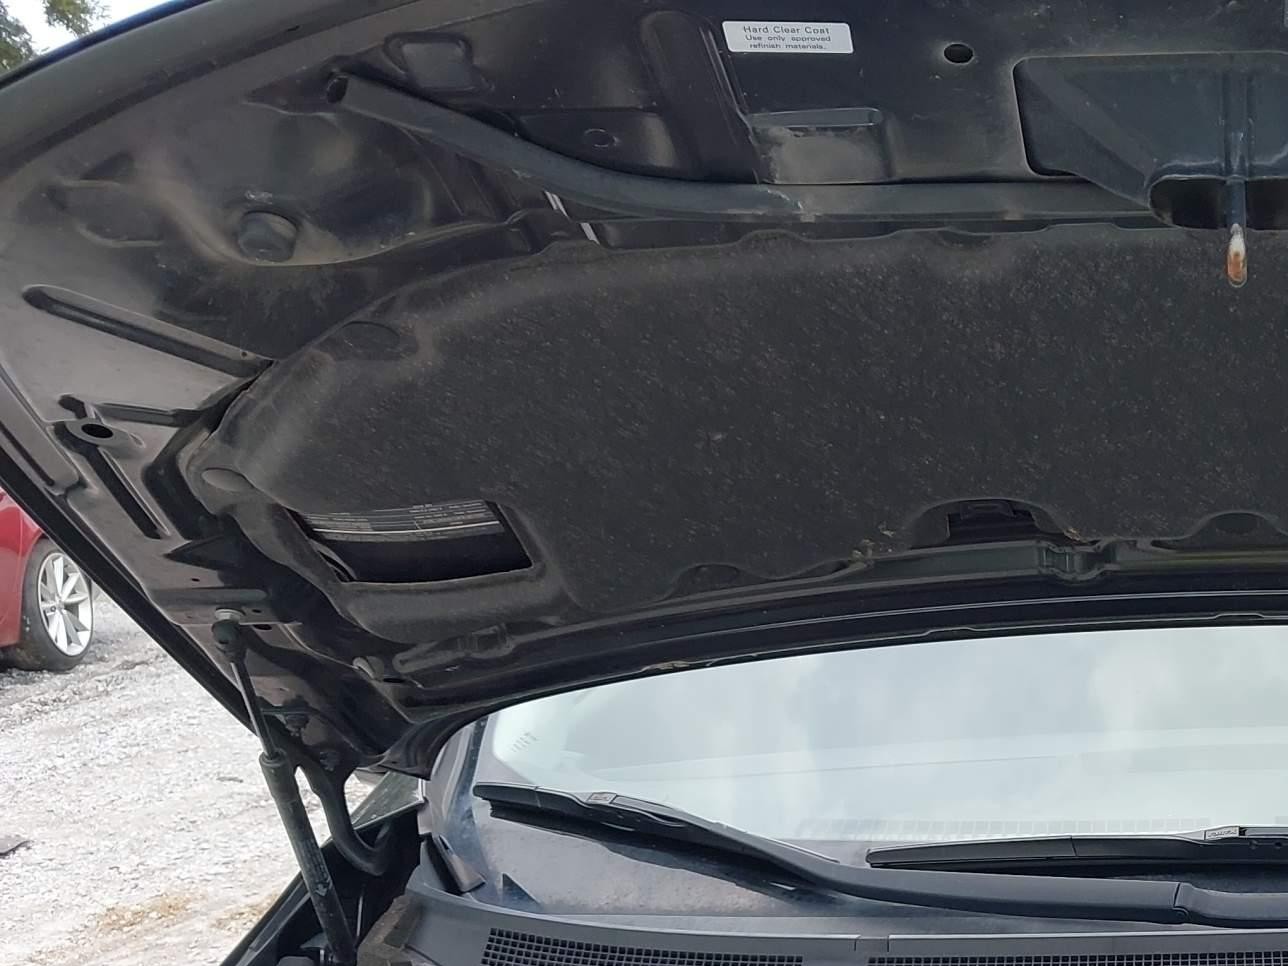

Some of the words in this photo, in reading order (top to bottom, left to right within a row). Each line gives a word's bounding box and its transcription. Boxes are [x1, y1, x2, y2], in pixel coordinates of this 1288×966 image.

[743, 25, 769, 34] Hard
[772, 25, 801, 34] Clear
[804, 26, 830, 35] Coat
